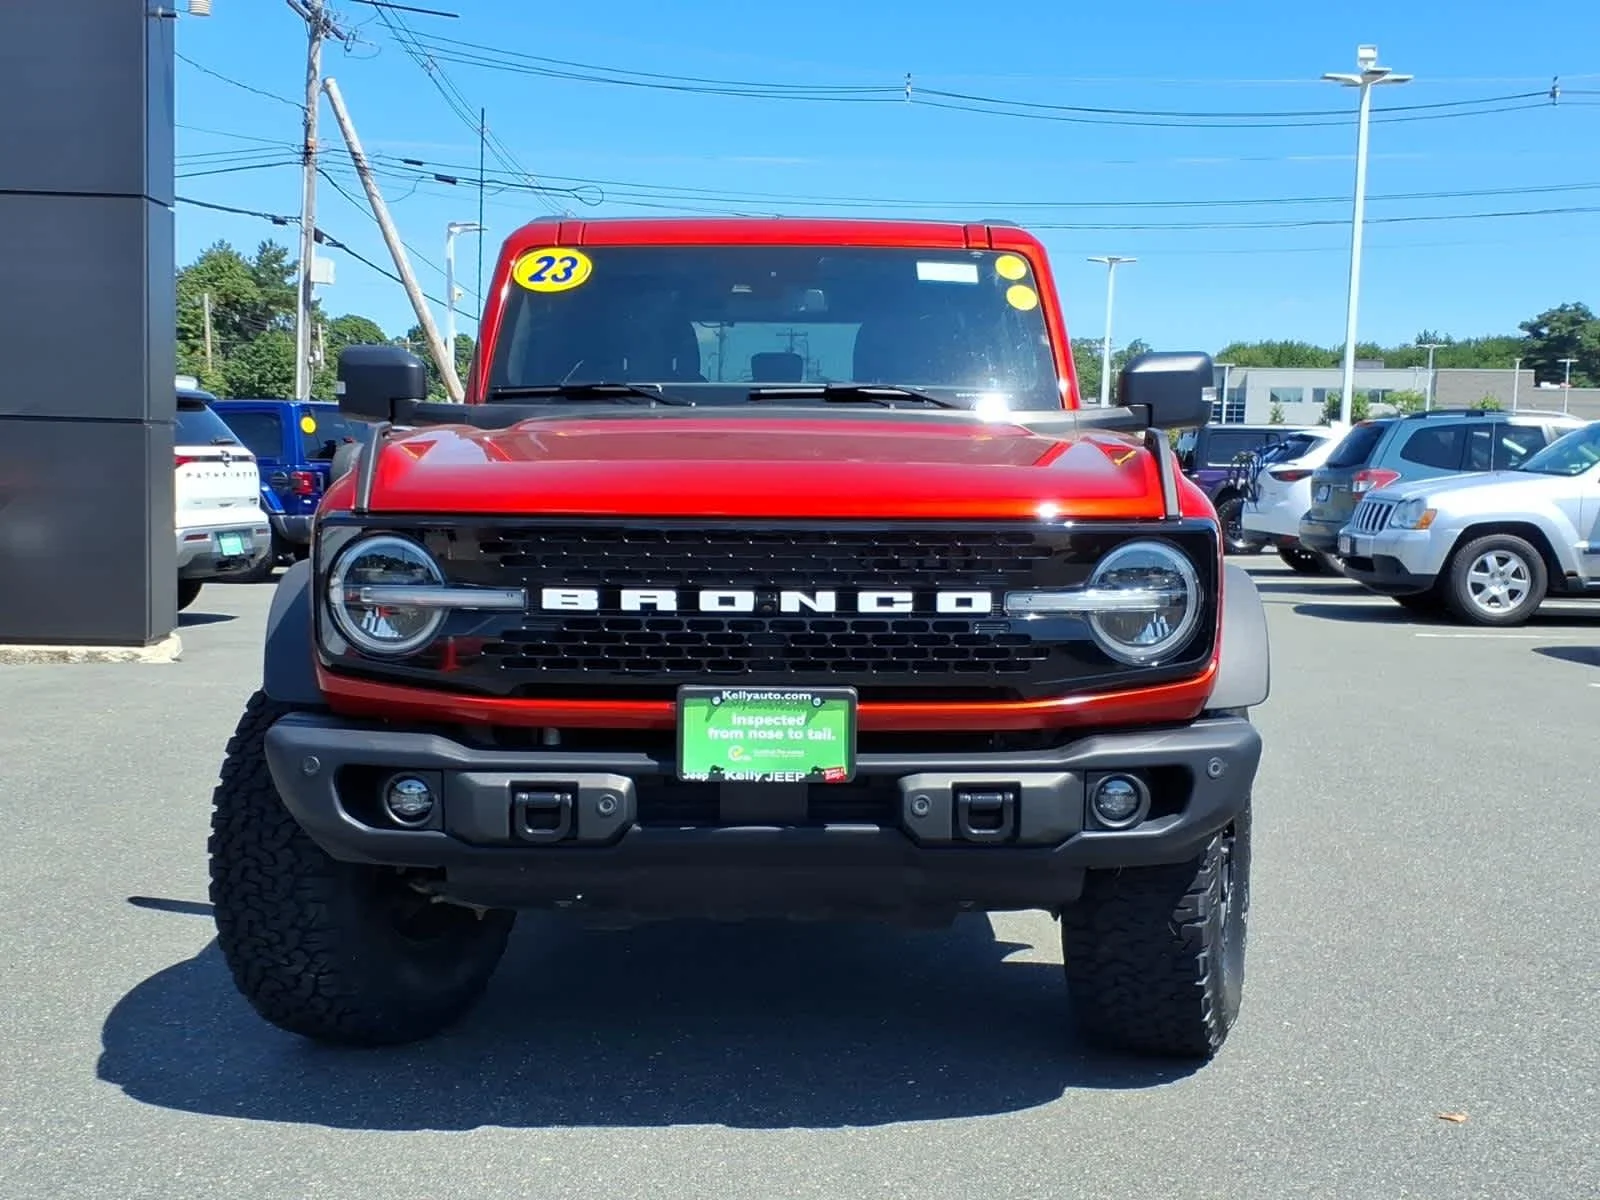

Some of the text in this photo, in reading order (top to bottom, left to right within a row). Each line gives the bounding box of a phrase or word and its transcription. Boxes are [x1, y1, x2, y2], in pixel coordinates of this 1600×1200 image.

[528, 255, 578, 283] 23
[541, 588, 992, 613] BRONCO
[721, 690, 812, 702] Kellyauto.com
[708, 727, 836, 741] from nose to tail.
[724, 770, 806, 782] Kelly JEEP
